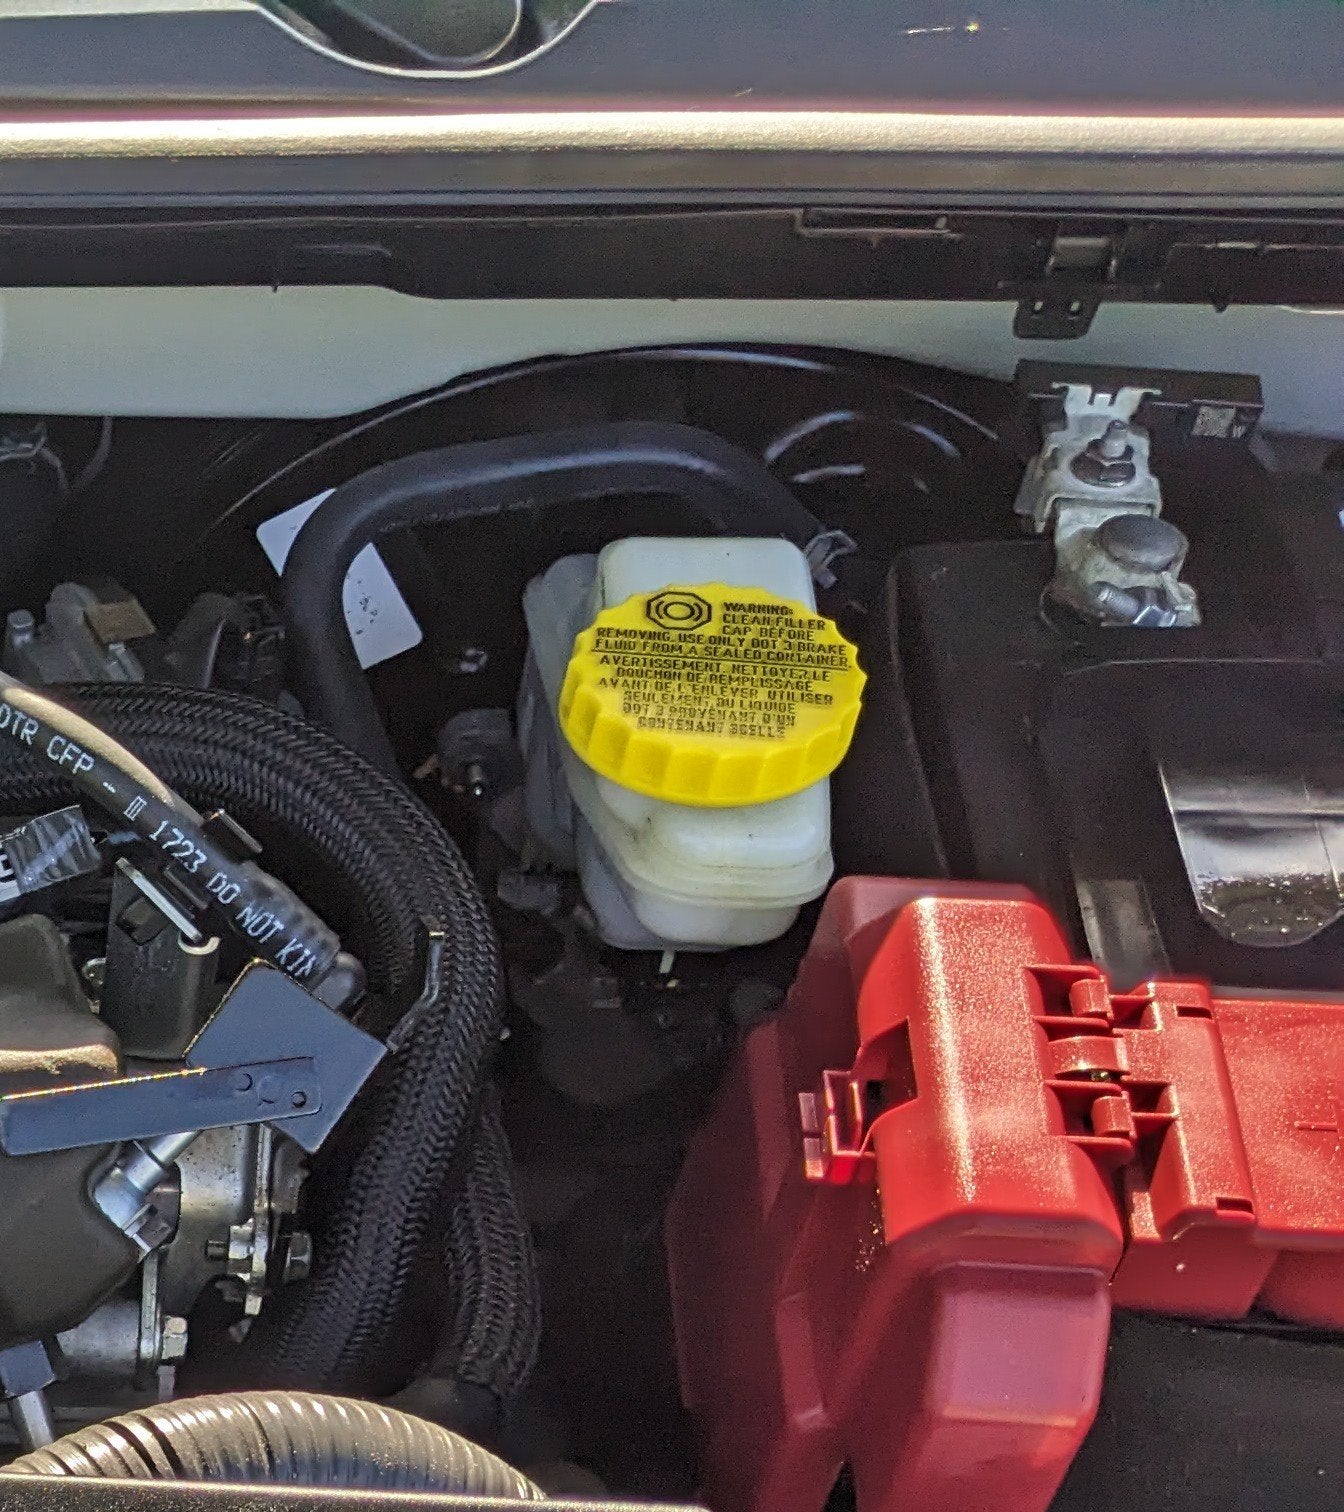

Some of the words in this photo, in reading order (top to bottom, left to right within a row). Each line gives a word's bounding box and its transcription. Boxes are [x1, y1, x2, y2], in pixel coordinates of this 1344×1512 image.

[721, 624, 753, 638] CAP
[758, 627, 815, 642] BEFORE
[722, 613, 772, 627] CLEAN
[775, 617, 826, 632] FILLER
[595, 638, 637, 651] FLUID
[642, 641, 683, 655] FROM
[686, 644, 699, 656] A
[703, 645, 764, 661] SEALED
[678, 633, 705, 646] USE
[708, 635, 745, 649] ONLY
[751, 638, 779, 651] DOT
[783, 640, 794, 652] 3
[796, 641, 848, 657] BRAKE
[686, 671, 703, 684] DE
[732, 662, 810, 681] NETTOYER
[813, 669, 832, 683] LE
[599, 677, 650, 691] AVANT
[654, 680, 674, 692] DE
[766, 689, 835, 706] UTILISER
[738, 699, 796, 714] LIQUIDE
[46, 735, 96, 777] CFP
[148, 818, 208, 875] 1723
[207, 870, 242, 905] DO
[238, 904, 284, 947] NOT
[274, 938, 322, 984] KIN
